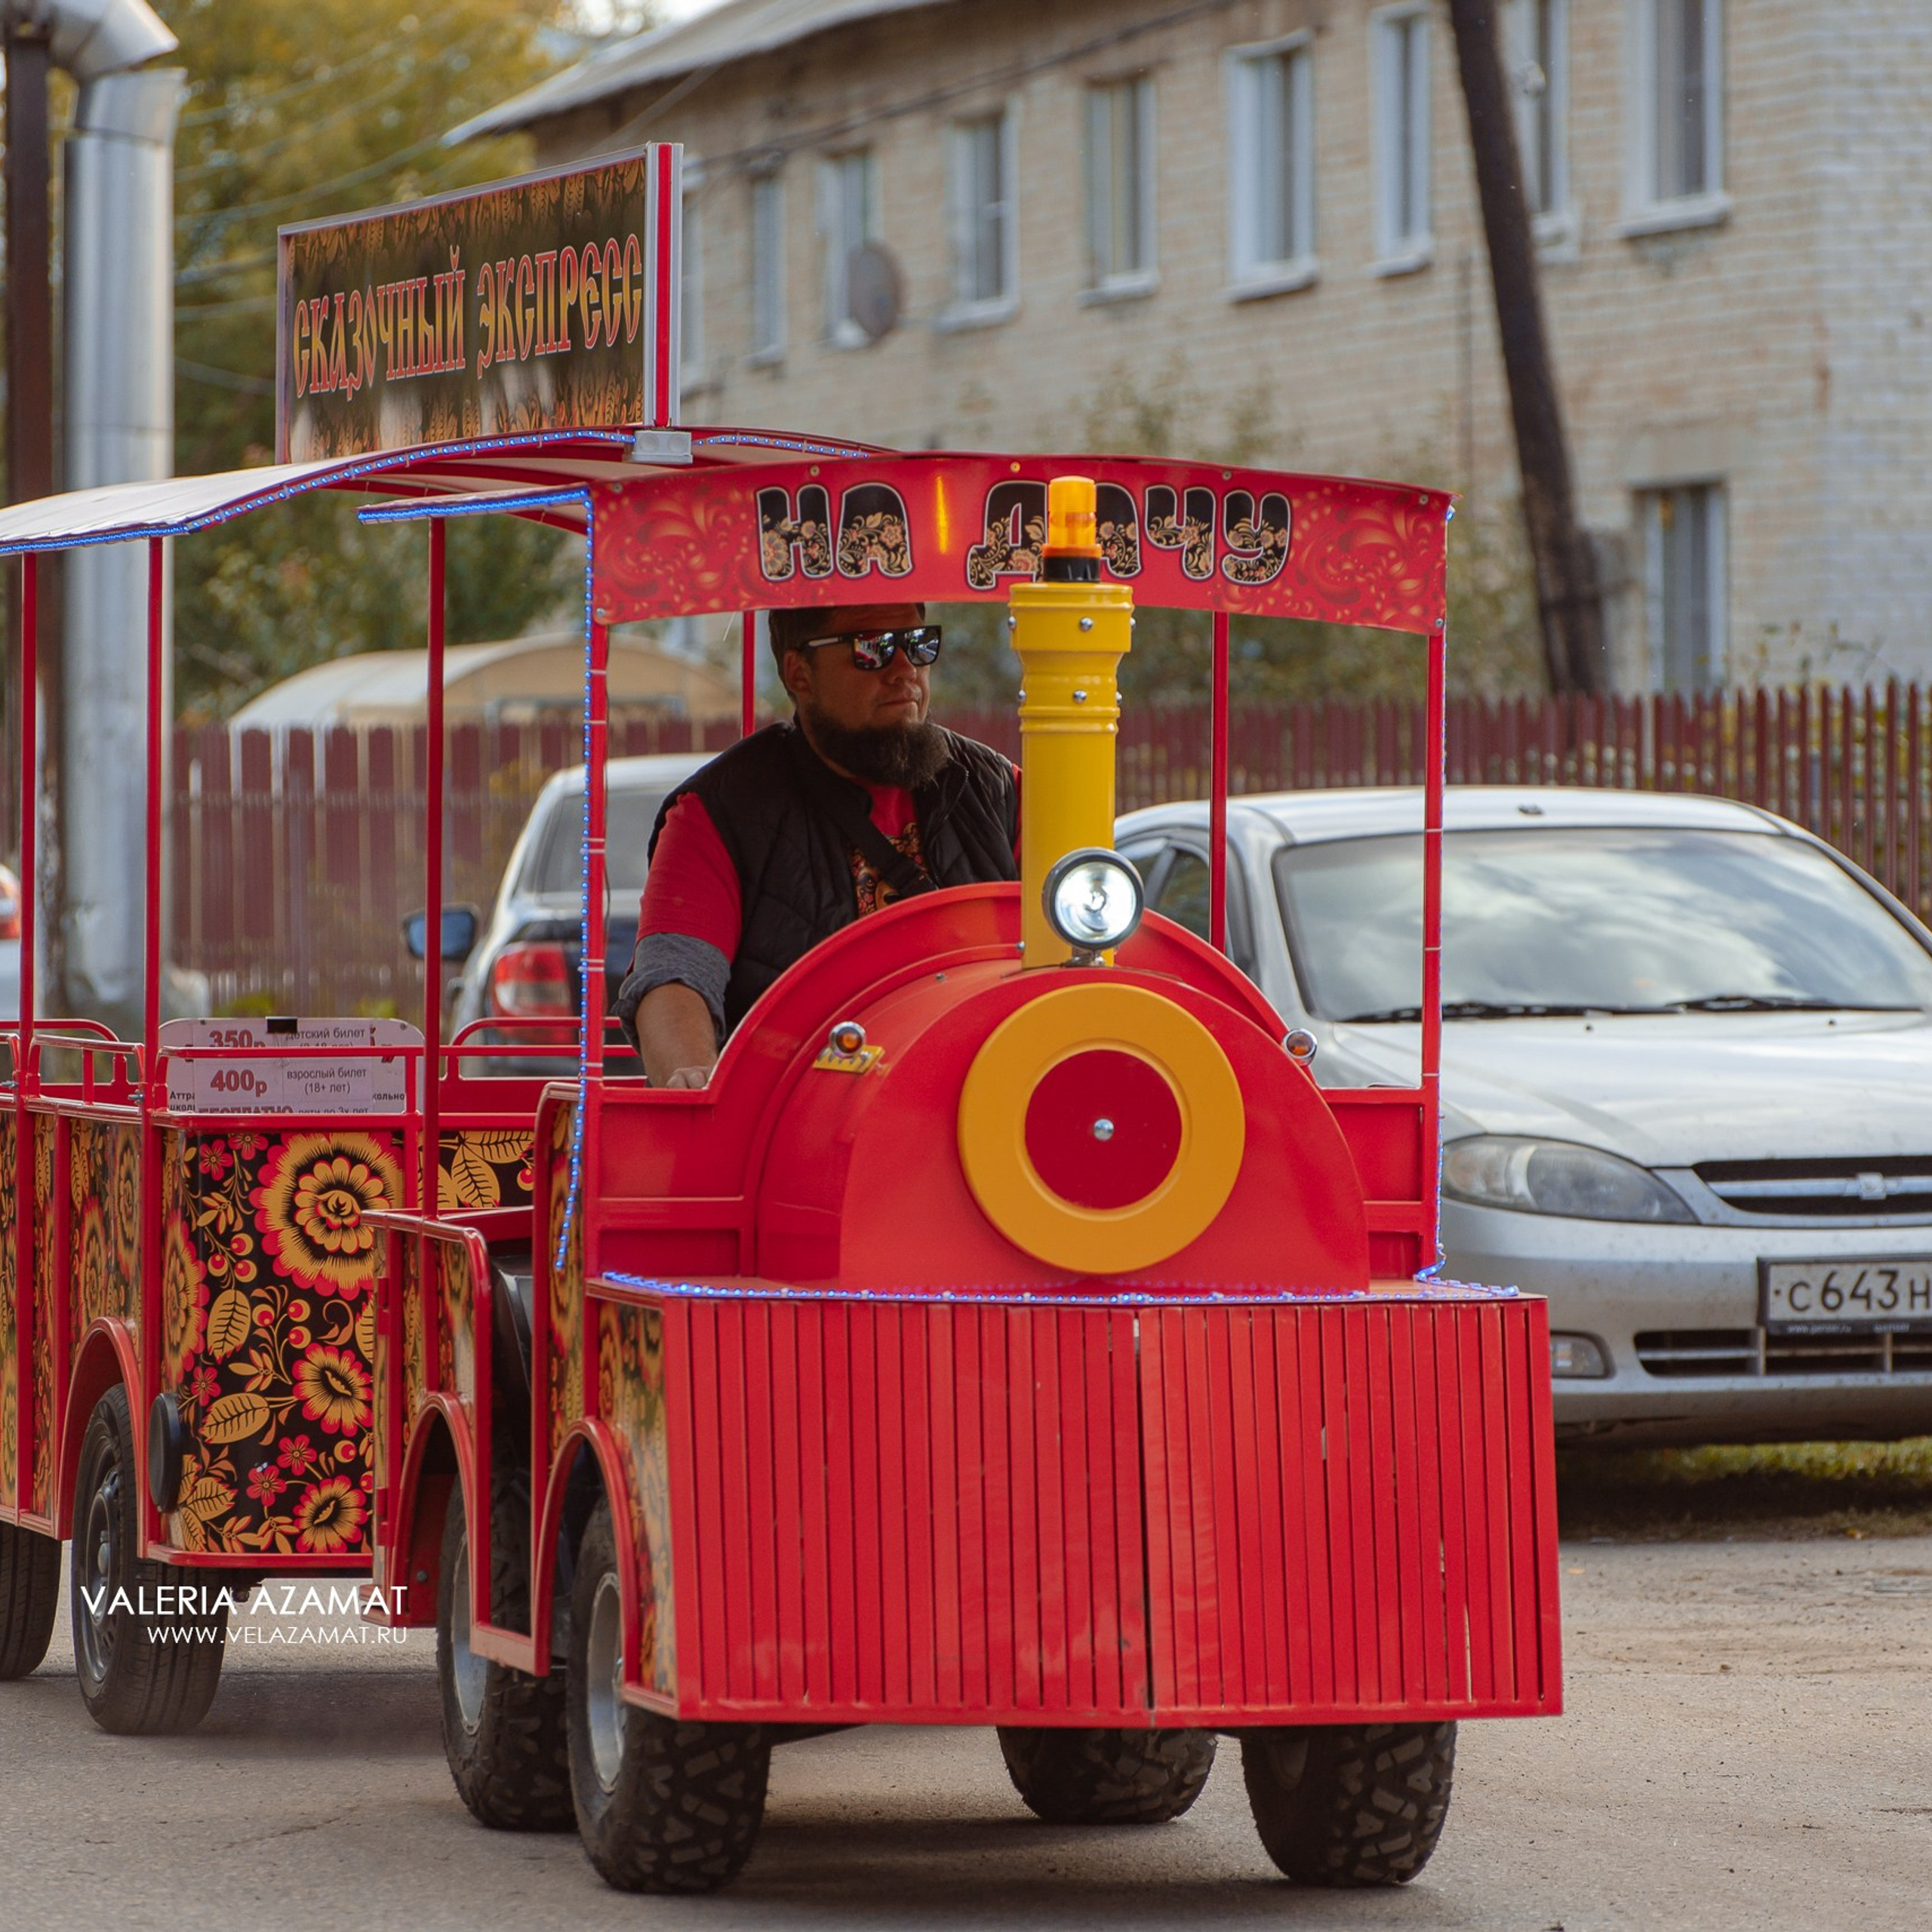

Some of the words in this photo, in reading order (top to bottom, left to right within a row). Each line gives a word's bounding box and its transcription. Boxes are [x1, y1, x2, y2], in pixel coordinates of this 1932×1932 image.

[293, 245, 466, 401] СКАЗОЧНЫЙ
[477, 234, 642, 380] ЭКСПРЕСС
[756, 481, 913, 582] НА
[967, 480, 1291, 589] ДАЧУ
[334, 1027, 365, 1038] билет
[211, 1069, 268, 1097] 400р
[287, 1068, 335, 1081] взрослый
[337, 1067, 367, 1077] билет
[304, 1082, 326, 1094] (18+
[330, 1081, 351, 1094] лет)
